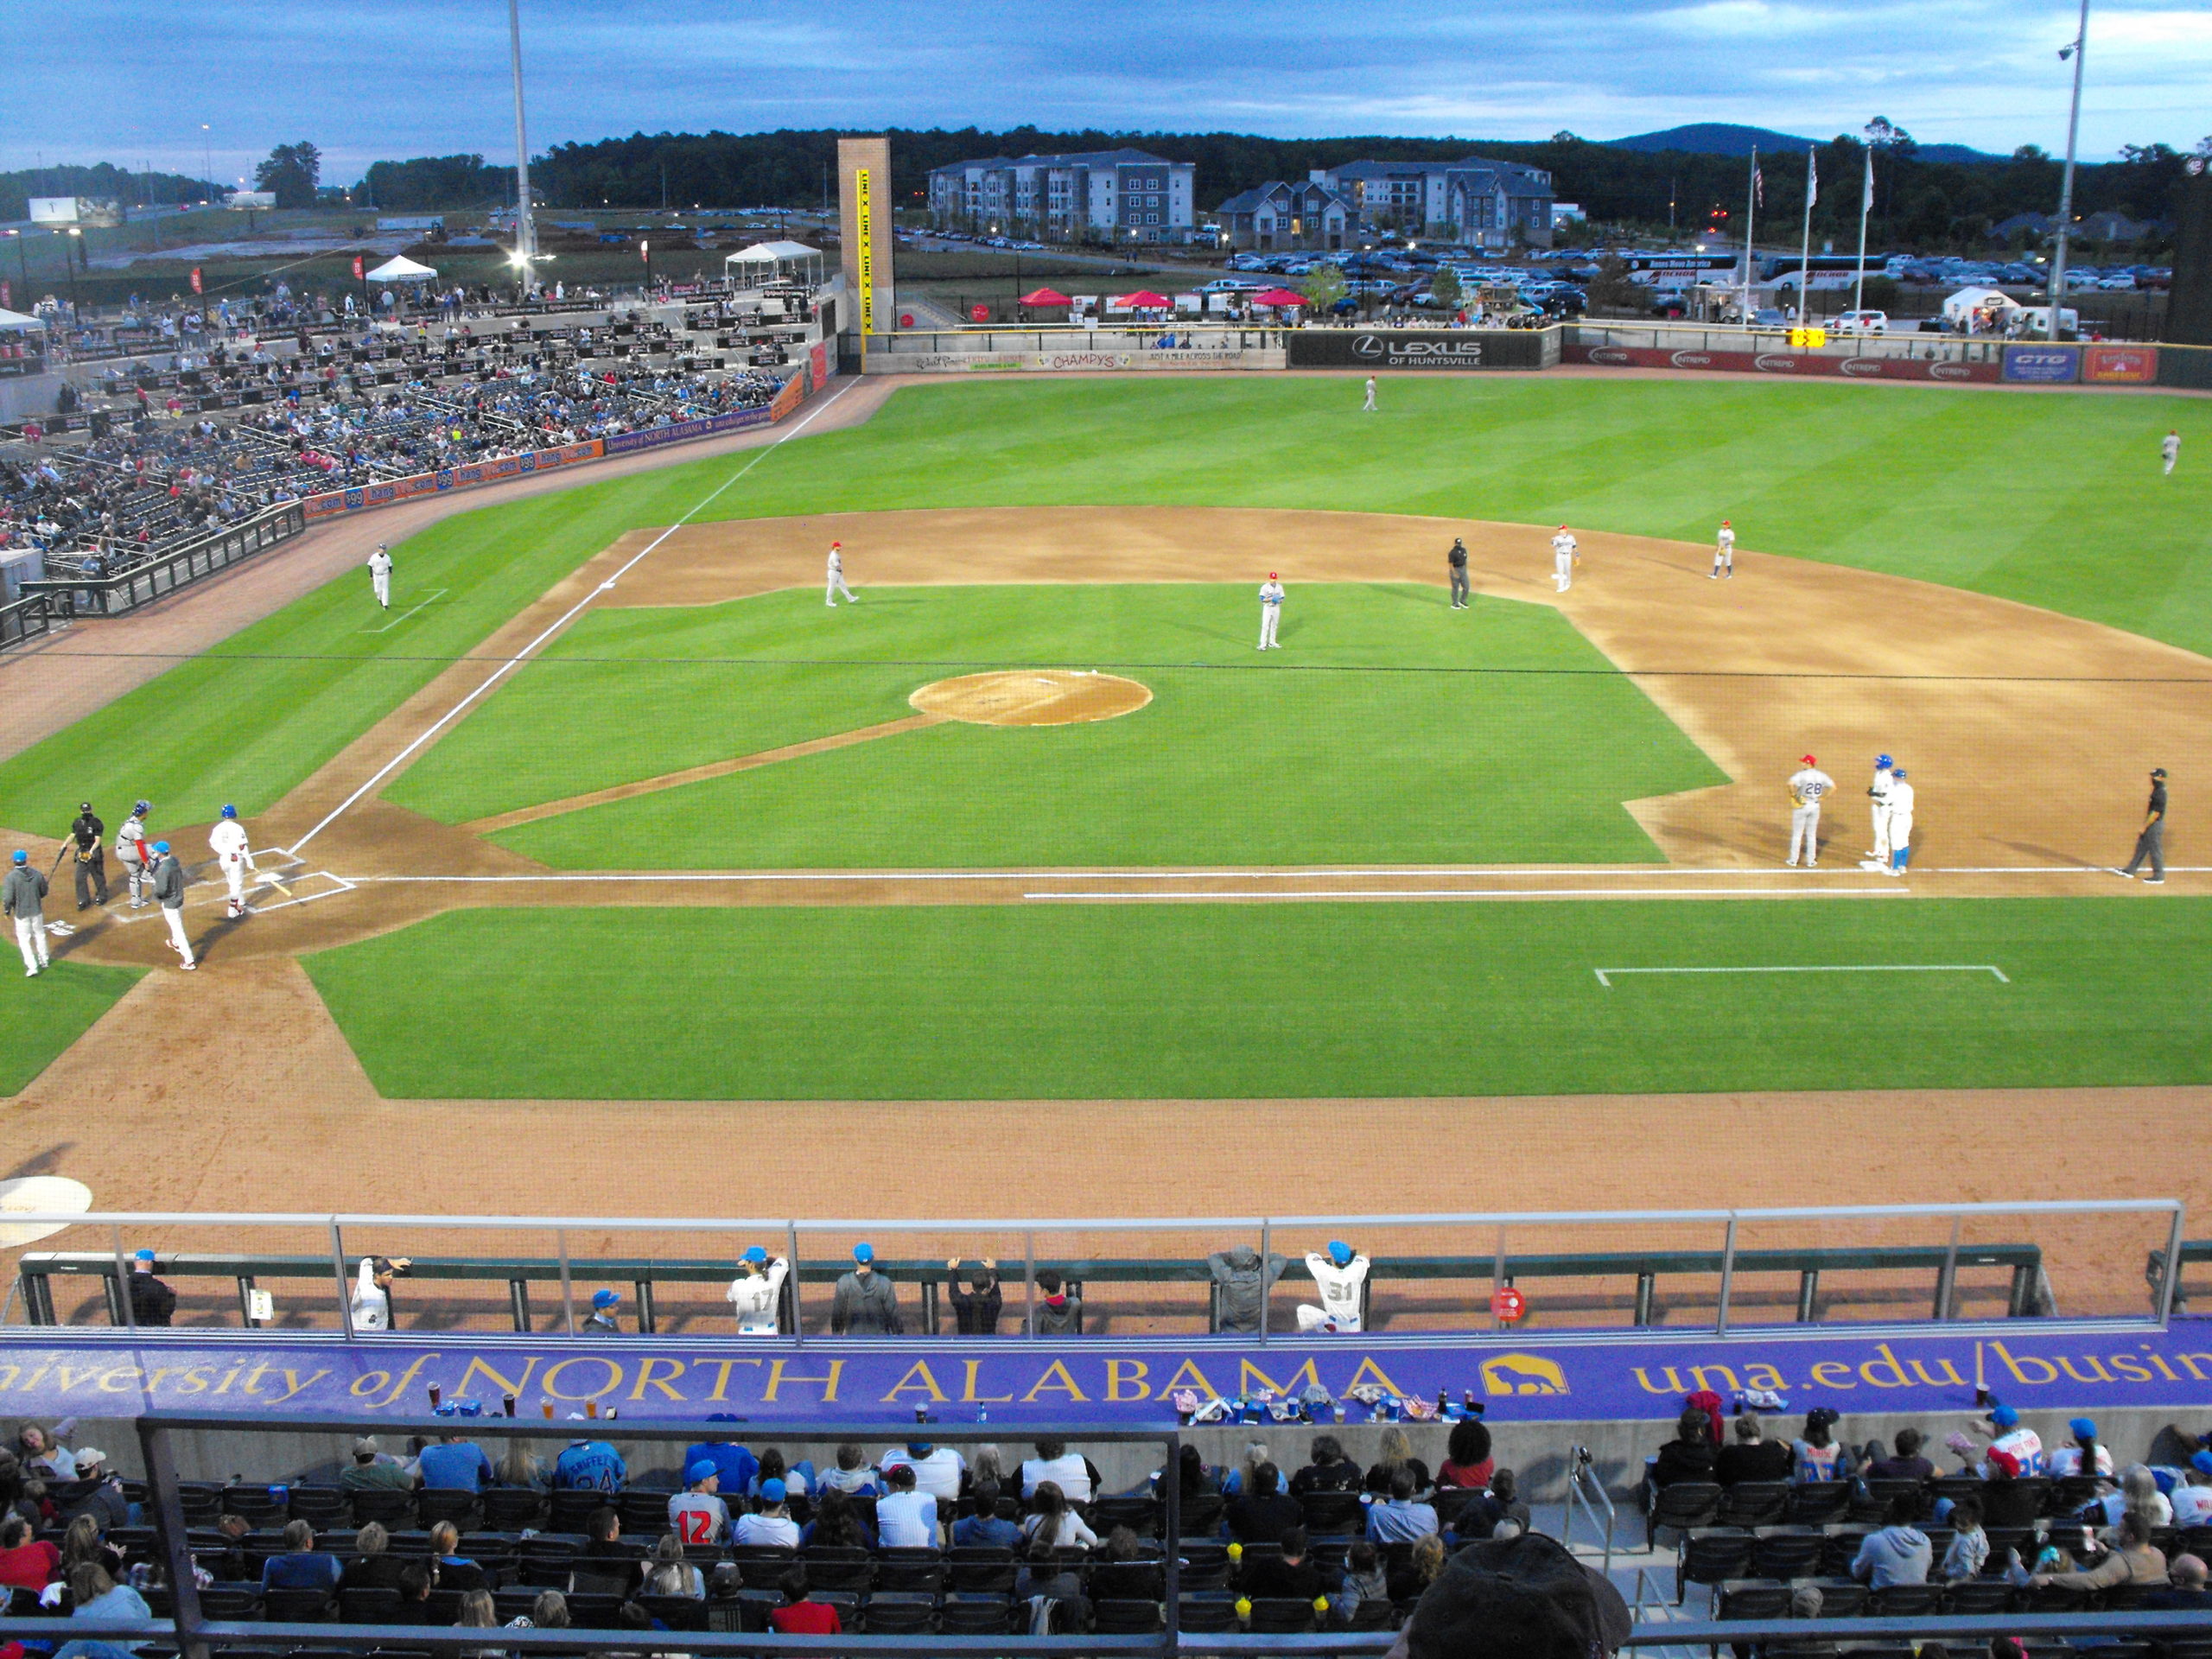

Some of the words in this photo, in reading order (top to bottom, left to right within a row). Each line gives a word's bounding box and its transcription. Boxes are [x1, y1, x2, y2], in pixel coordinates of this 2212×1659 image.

[1388, 341, 1481, 355] LEXUS
[1053, 354, 1116, 369] CHAMPY'S
[1389, 356, 1406, 365] OF
[1408, 356, 1481, 366] HUNTSVILLE
[607, 438, 638, 451] University
[645, 429, 671, 442] NORTH
[671, 423, 702, 436] ALABAMA
[520, 454, 535, 469] $99
[437, 473, 454, 488] $99
[346, 491, 364, 506] $99
[1805, 783, 1823, 795] 28
[1327, 1281, 1353, 1302] 31
[752, 1288, 774, 1312] 17
[350, 1353, 440, 1408] of
[449, 1356, 845, 1402] NORTH
[878, 1357, 1407, 1404] ALABAMA
[676, 1510, 712, 1544] 12
